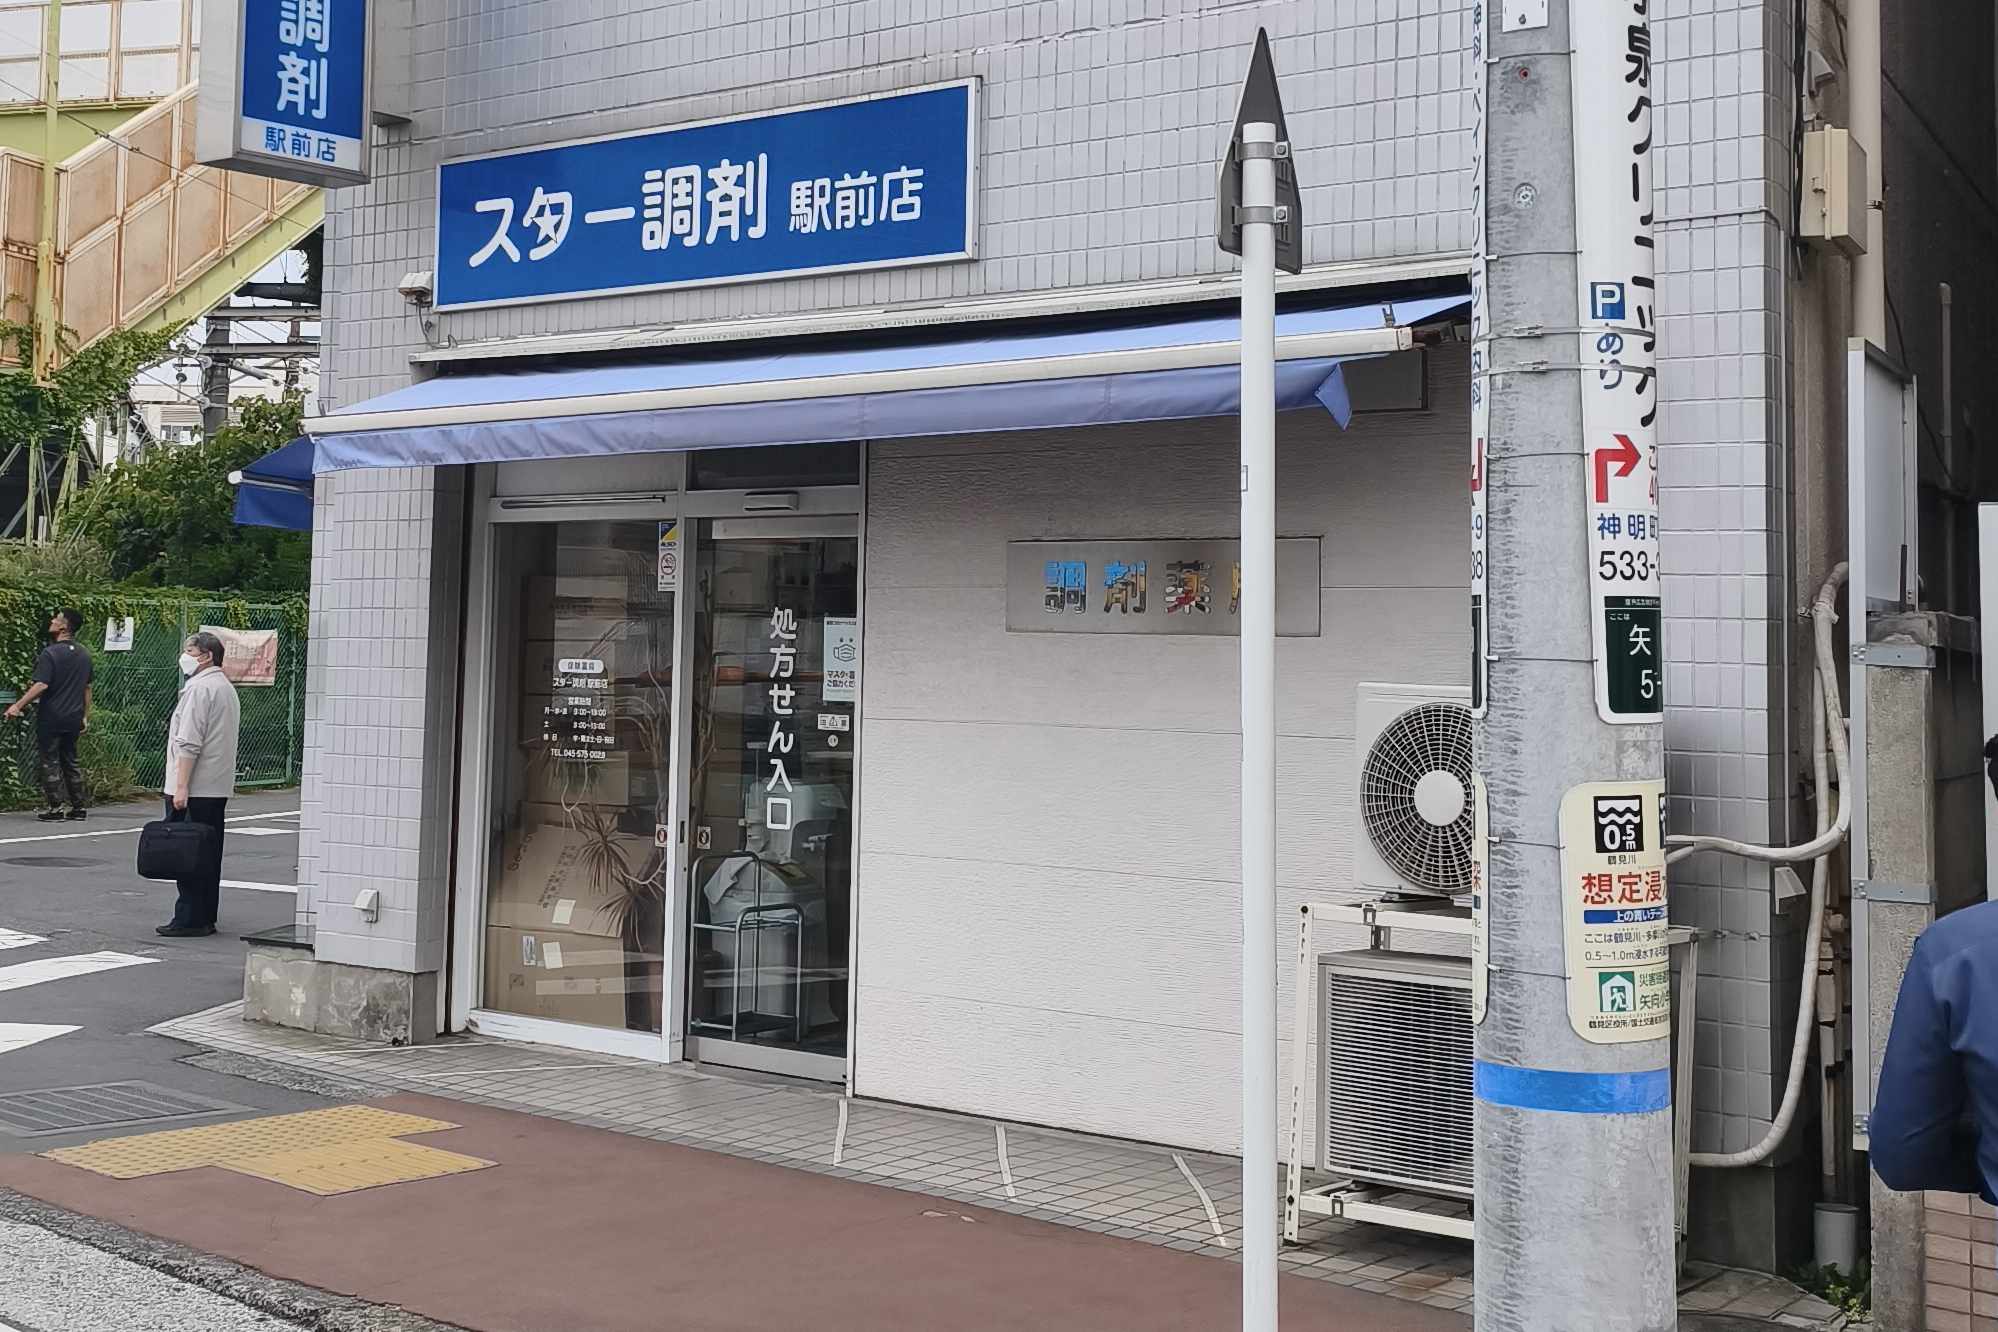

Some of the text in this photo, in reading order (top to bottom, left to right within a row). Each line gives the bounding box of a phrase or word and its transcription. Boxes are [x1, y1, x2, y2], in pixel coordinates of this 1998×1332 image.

[265, 126, 337, 163] 駅前店
[469, 152, 924, 268] スター調剤 駅前店
[1596, 284, 1621, 318] P
[1043, 560, 1240, 616] 調剤薬
[766, 606, 798, 831] 処方せん入口
